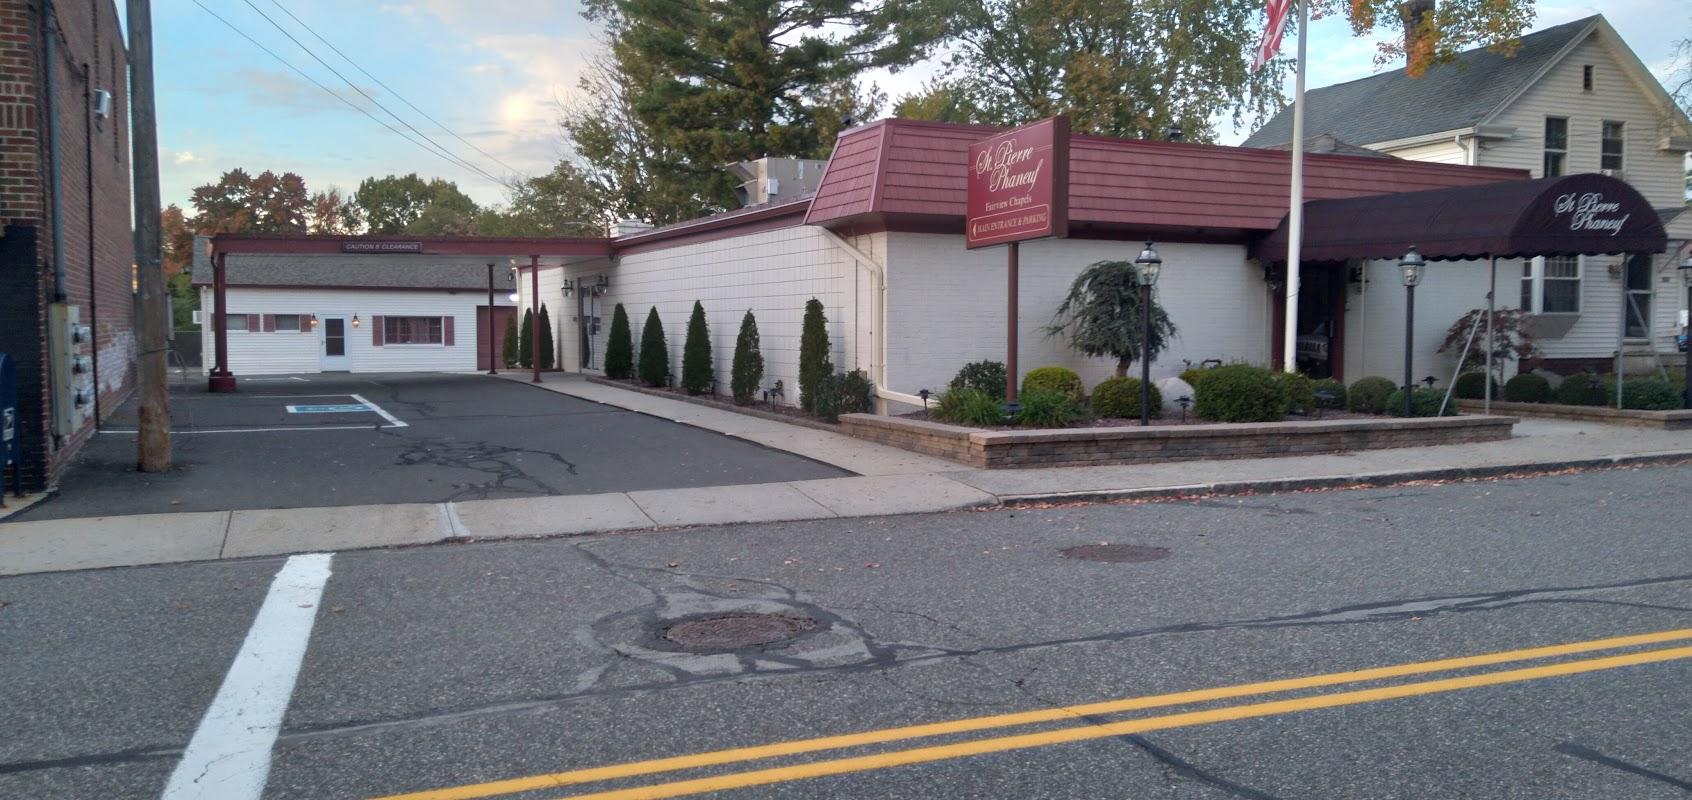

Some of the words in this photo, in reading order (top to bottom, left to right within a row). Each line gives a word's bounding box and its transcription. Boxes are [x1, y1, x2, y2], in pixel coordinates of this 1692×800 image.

[976, 146, 993, 180] St.
[995, 139, 1034, 169] Pierre
[989, 158, 1044, 193] Phaneuf
[985, 200, 1008, 212] Fairview
[1009, 194, 1032, 207] Chapels
[1577, 192, 1620, 213] Pierre
[977, 223, 990, 233] MAIN
[991, 217, 1016, 231] ENTRANCE
[1023, 212, 1047, 225] PARKING
[1570, 211, 1630, 237] Phaneuf
